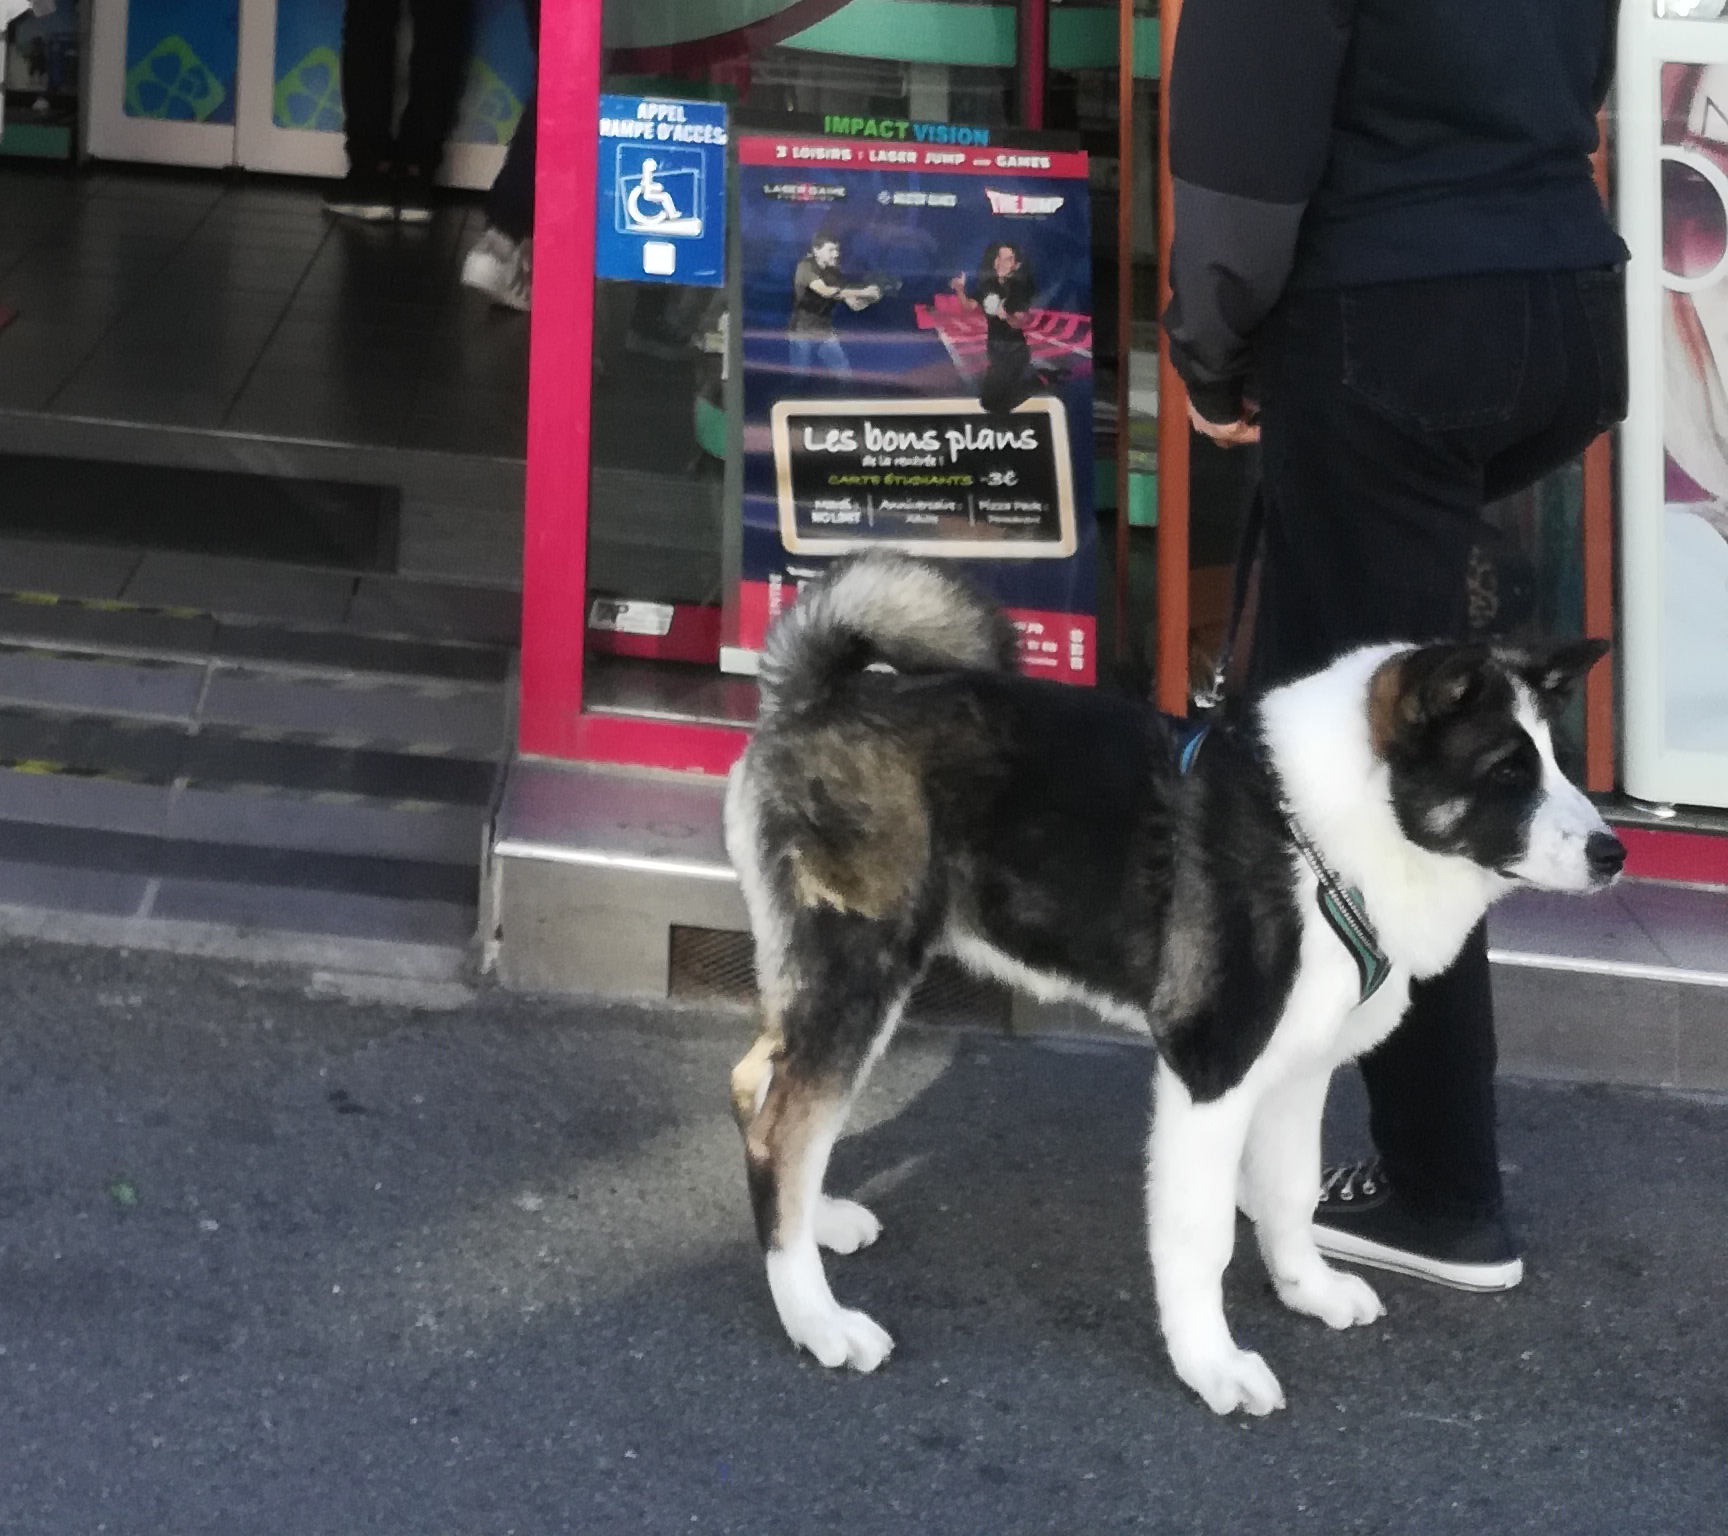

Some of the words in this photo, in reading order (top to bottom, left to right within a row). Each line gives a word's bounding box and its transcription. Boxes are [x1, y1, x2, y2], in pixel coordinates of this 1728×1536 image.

[636, 101, 687, 123] APPEL
[599, 117, 655, 139] RAMPE
[823, 114, 910, 140] IMPACT
[913, 122, 991, 147] VISION
[802, 426, 860, 453] Les
[863, 420, 941, 452] bons
[943, 423, 1039, 464] plans
